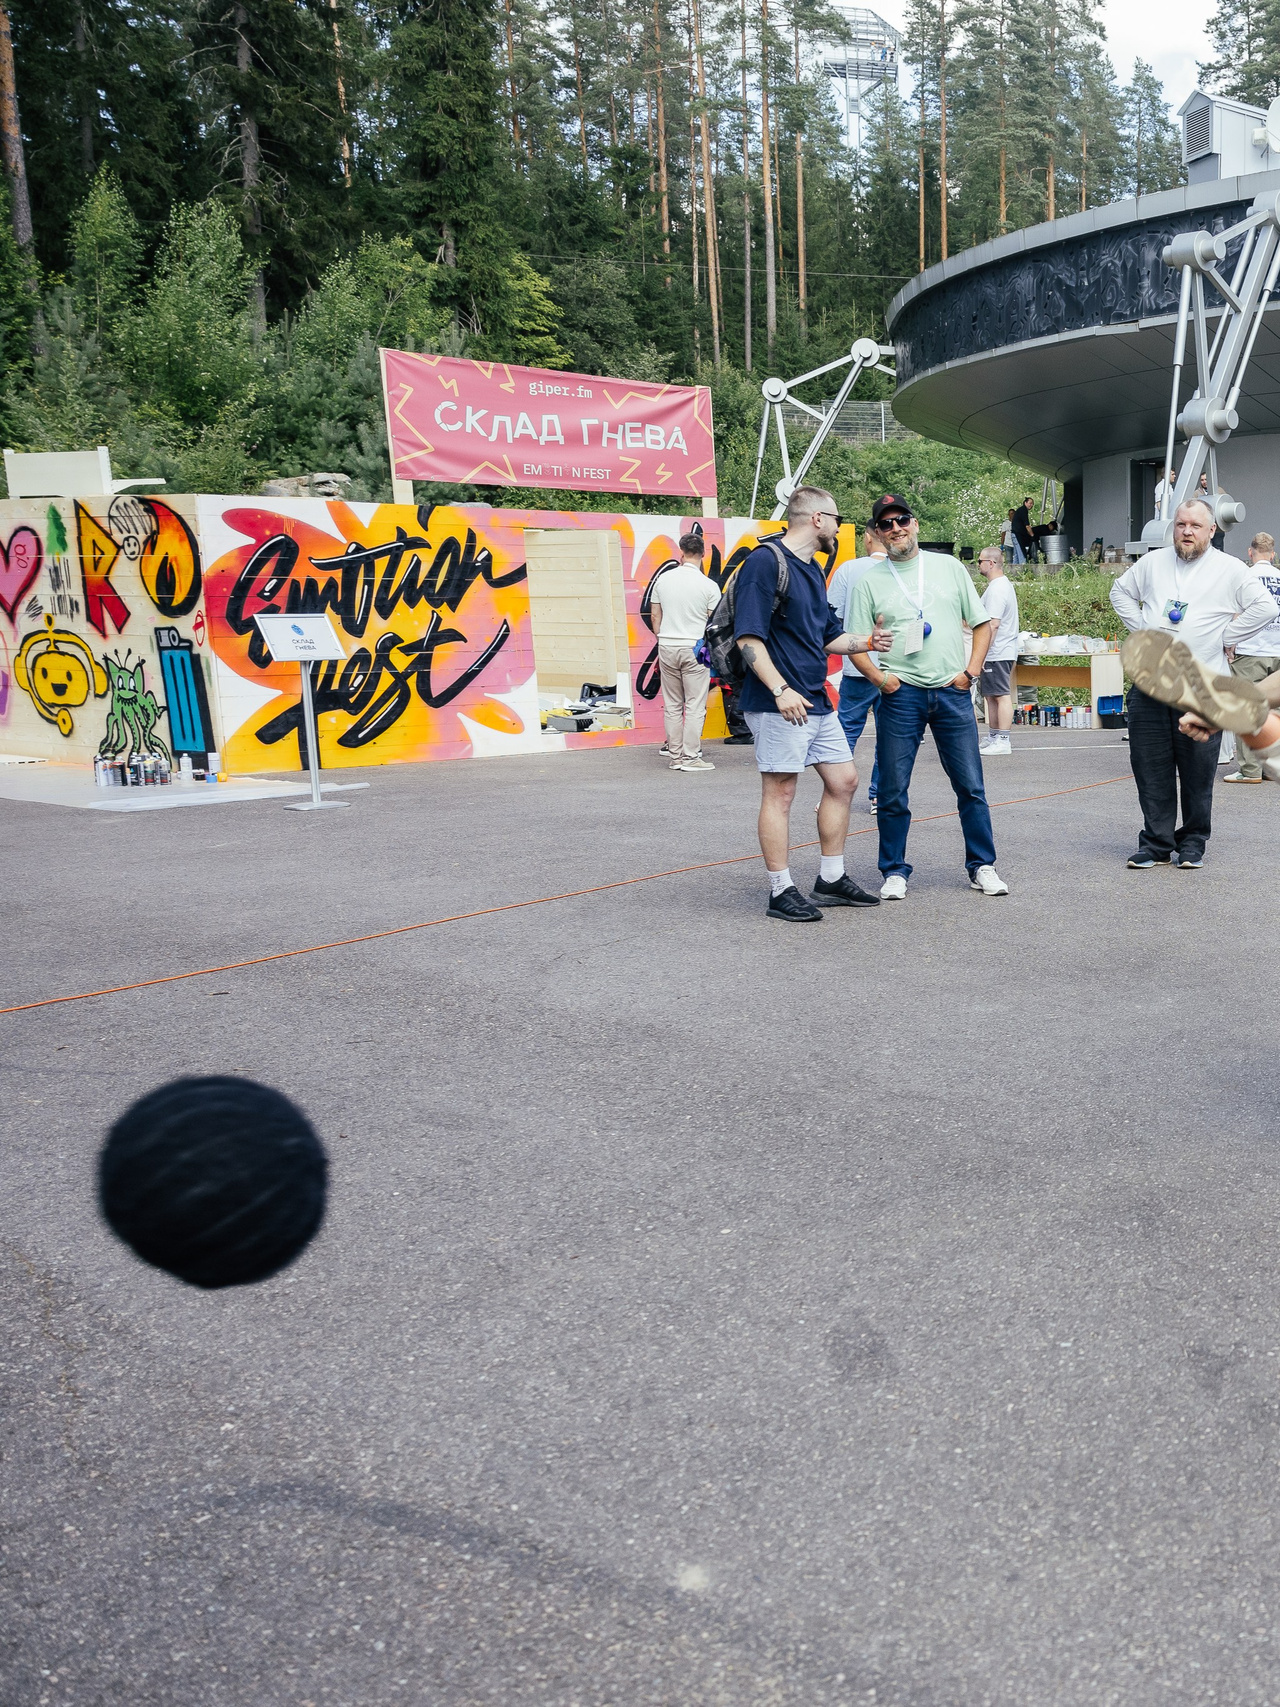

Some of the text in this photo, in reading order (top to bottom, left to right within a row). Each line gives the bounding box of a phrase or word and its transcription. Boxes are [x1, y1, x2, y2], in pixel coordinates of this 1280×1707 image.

[529, 381, 593, 399] giper.fm
[434, 401, 689, 456] СКЛАД ГНЕВА
[583, 467, 612, 480] FEST
